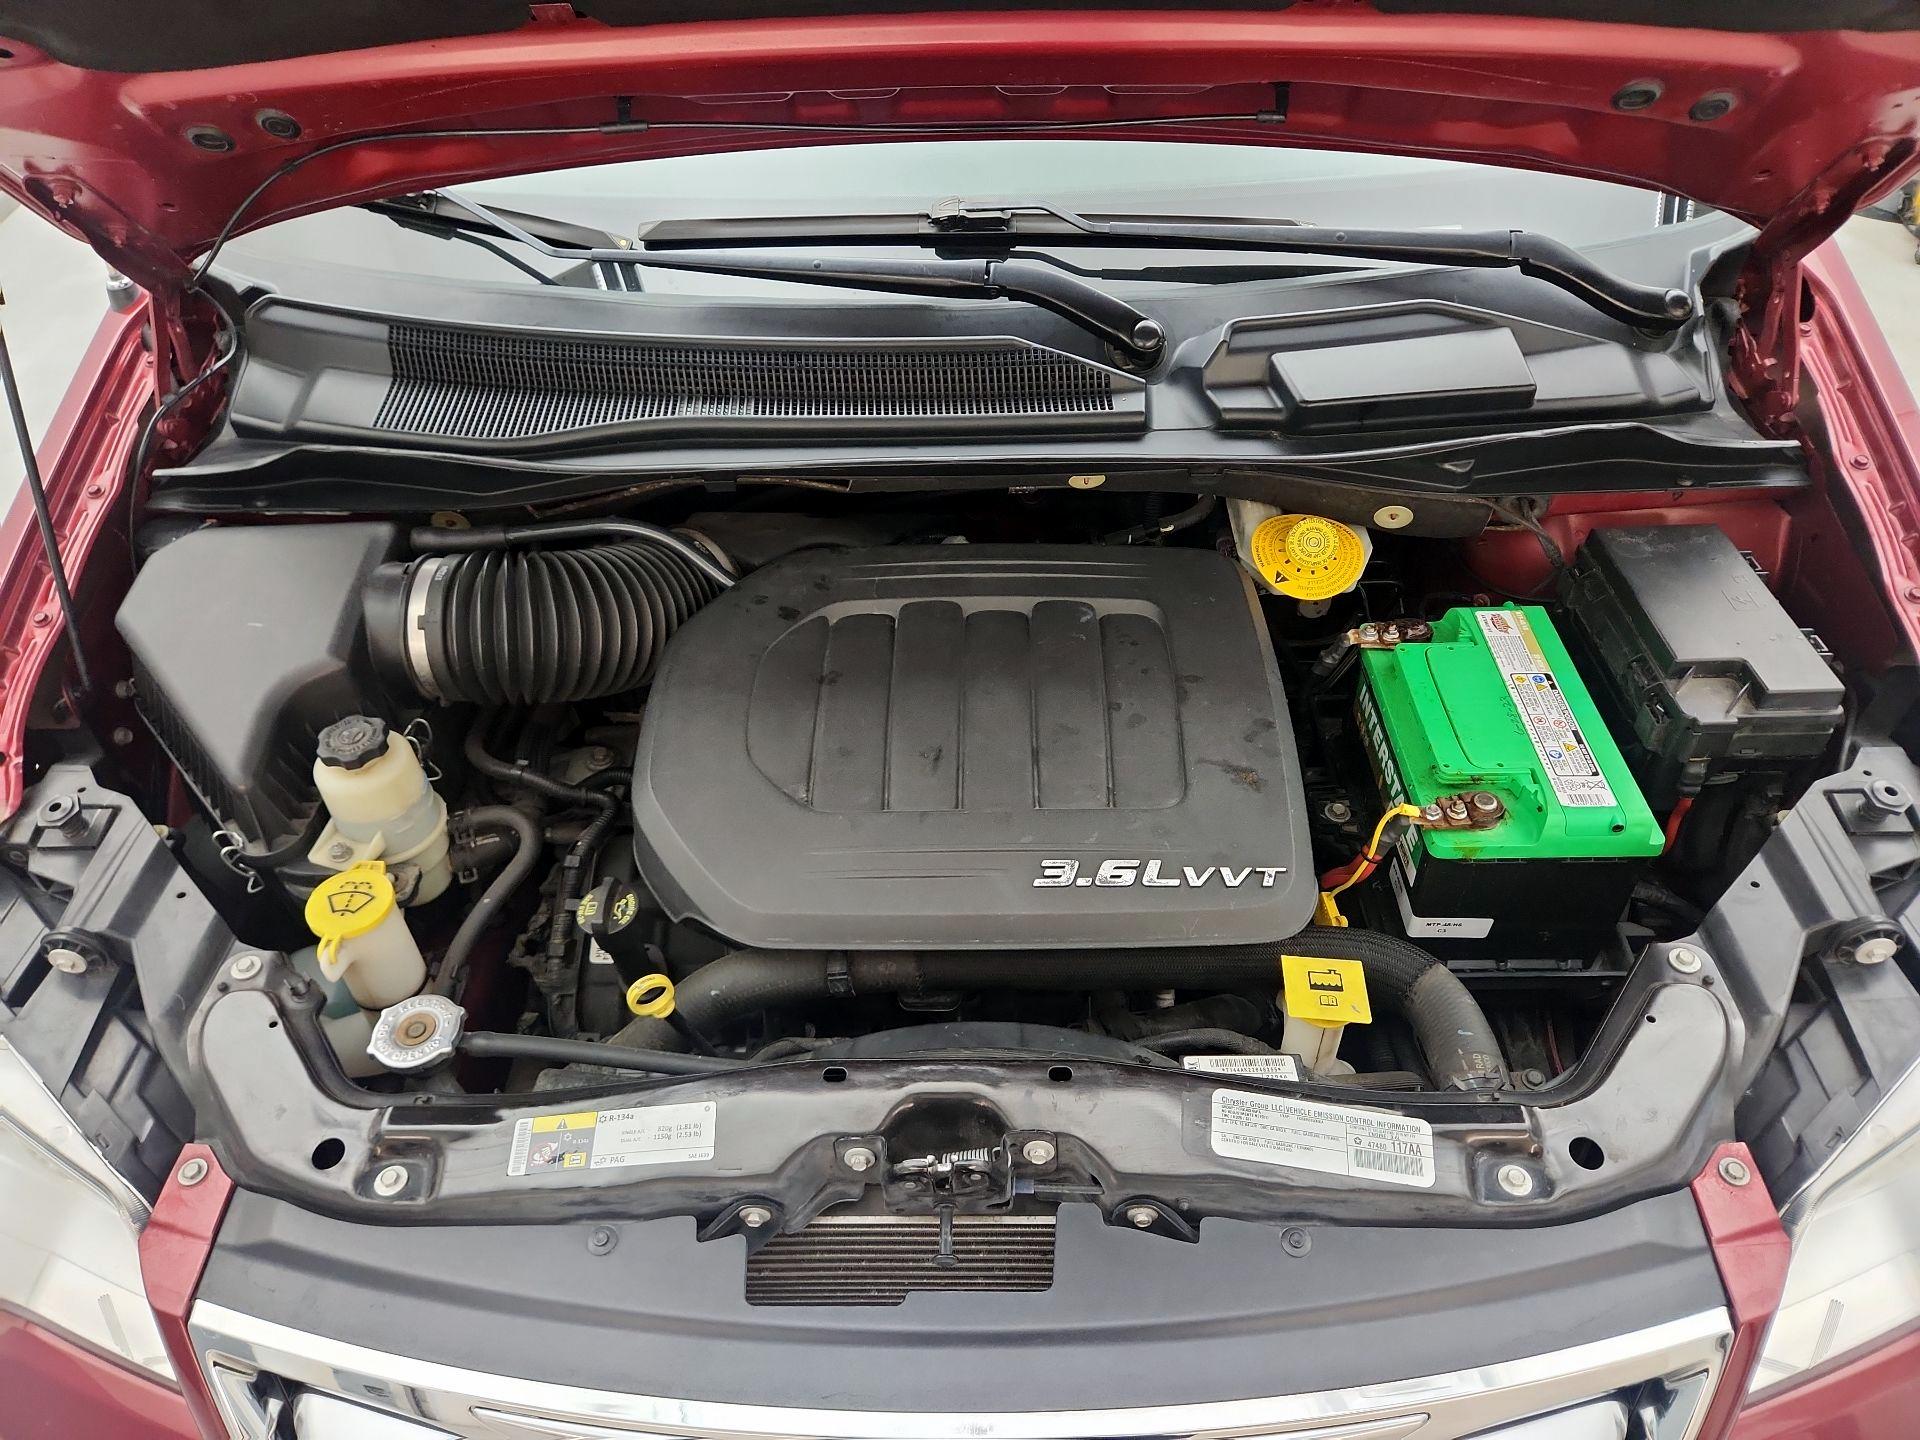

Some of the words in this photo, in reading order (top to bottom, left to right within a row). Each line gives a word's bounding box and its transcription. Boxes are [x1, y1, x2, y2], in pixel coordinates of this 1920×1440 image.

[1359, 684, 1418, 852] INTERSTAE
[609, 1112, 634, 1122] R-134a
[1222, 1096, 1248, 1106] Chrysler
[1250, 1100, 1268, 1110] Group
[1285, 1105, 1312, 1116] VEHICLE
[1314, 1110, 1344, 1121] EMISSION
[1346, 1116, 1374, 1126] CONTROL
[1376, 1120, 1421, 1133] INFORMATION
[1391, 1142, 1422, 1156] 117AA
[609, 1155, 625, 1164] PAG
